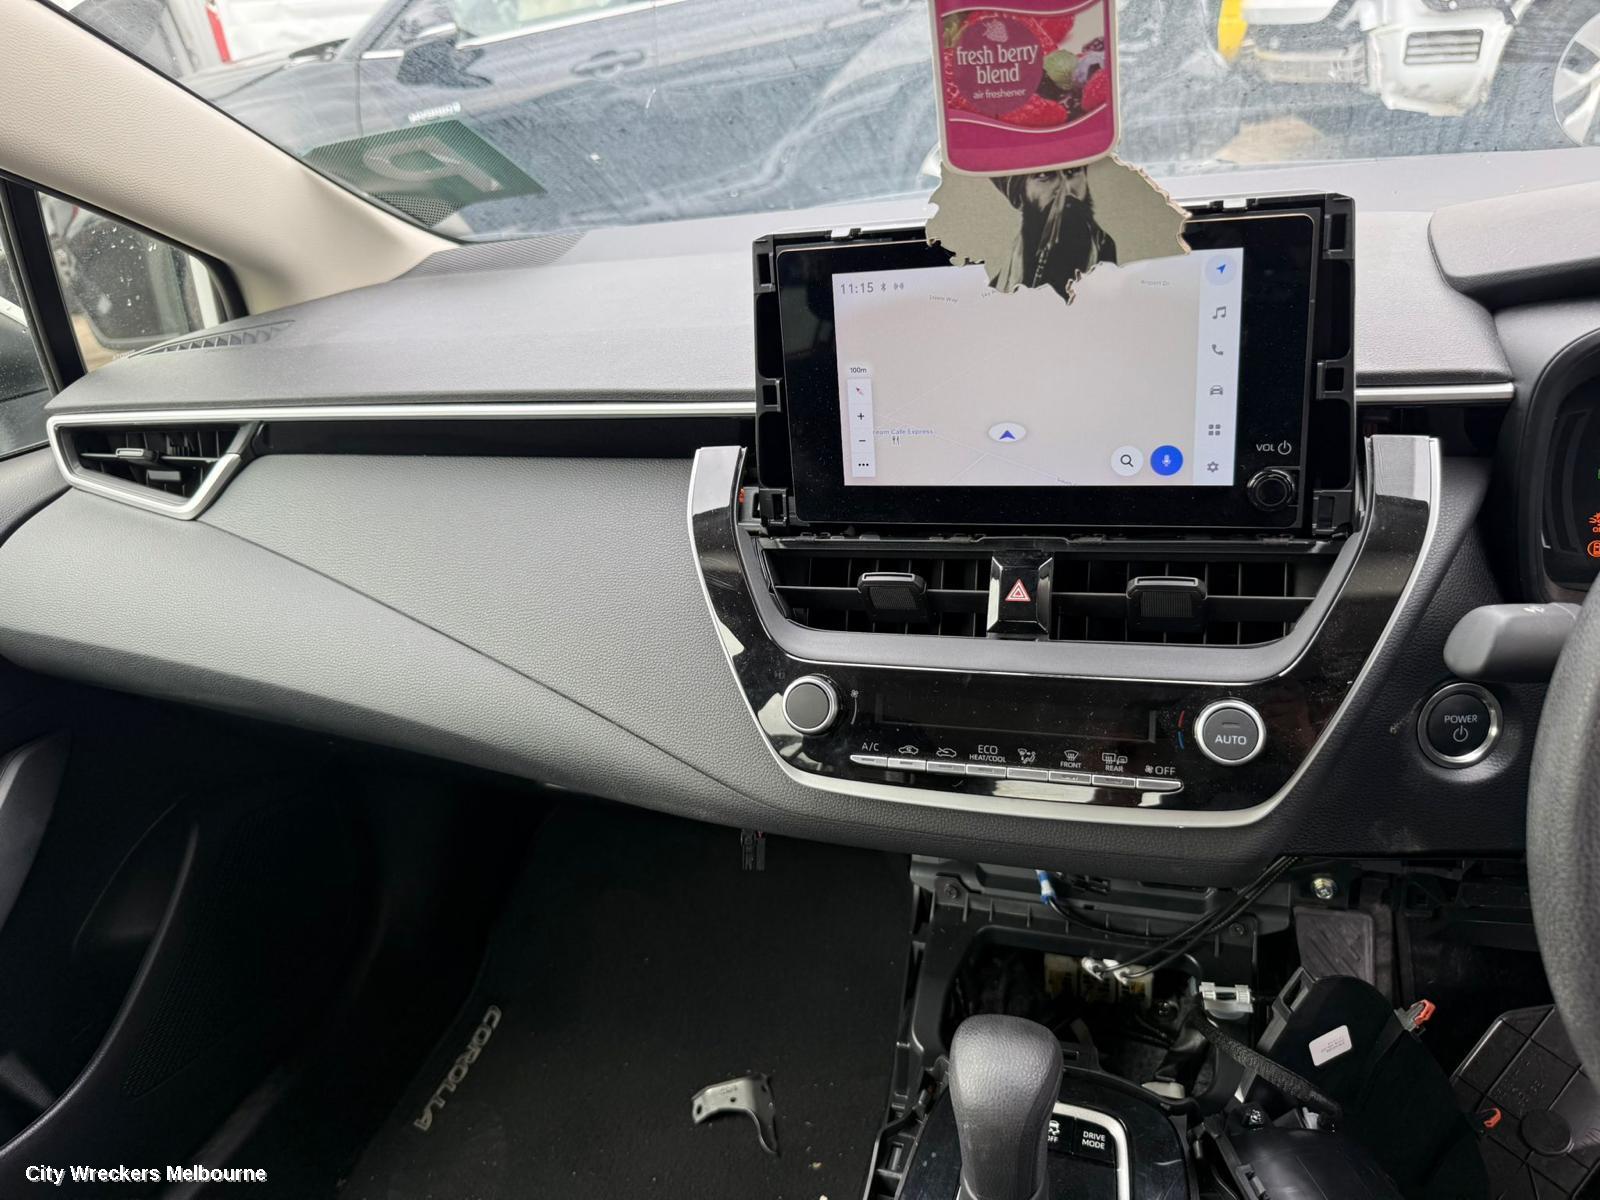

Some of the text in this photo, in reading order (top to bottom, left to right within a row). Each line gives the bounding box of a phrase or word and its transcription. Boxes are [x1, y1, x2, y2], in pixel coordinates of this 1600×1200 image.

[956, 44, 1039, 65] fresh berry
[976, 63, 1020, 84] blend
[973, 88, 1027, 100] air freshener
[840, 281, 874, 294] 11:15
[850, 366, 867, 374] 100m
[1255, 443, 1275, 453] VOL
[1444, 713, 1478, 724] POWER
[1214, 734, 1247, 746] AUTO
[861, 741, 880, 752] A/C
[977, 744, 998, 755] ECO
[969, 753, 1007, 763] HEAT/COOL
[1060, 760, 1082, 769] FRONT
[1104, 763, 1124, 772] REAR
[1154, 765, 1176, 775] OFF
[413, 1004, 502, 1131] COROLLA
[1082, 1130, 1106, 1142] DRIVE
[1081, 1139, 1105, 1150] MODE
